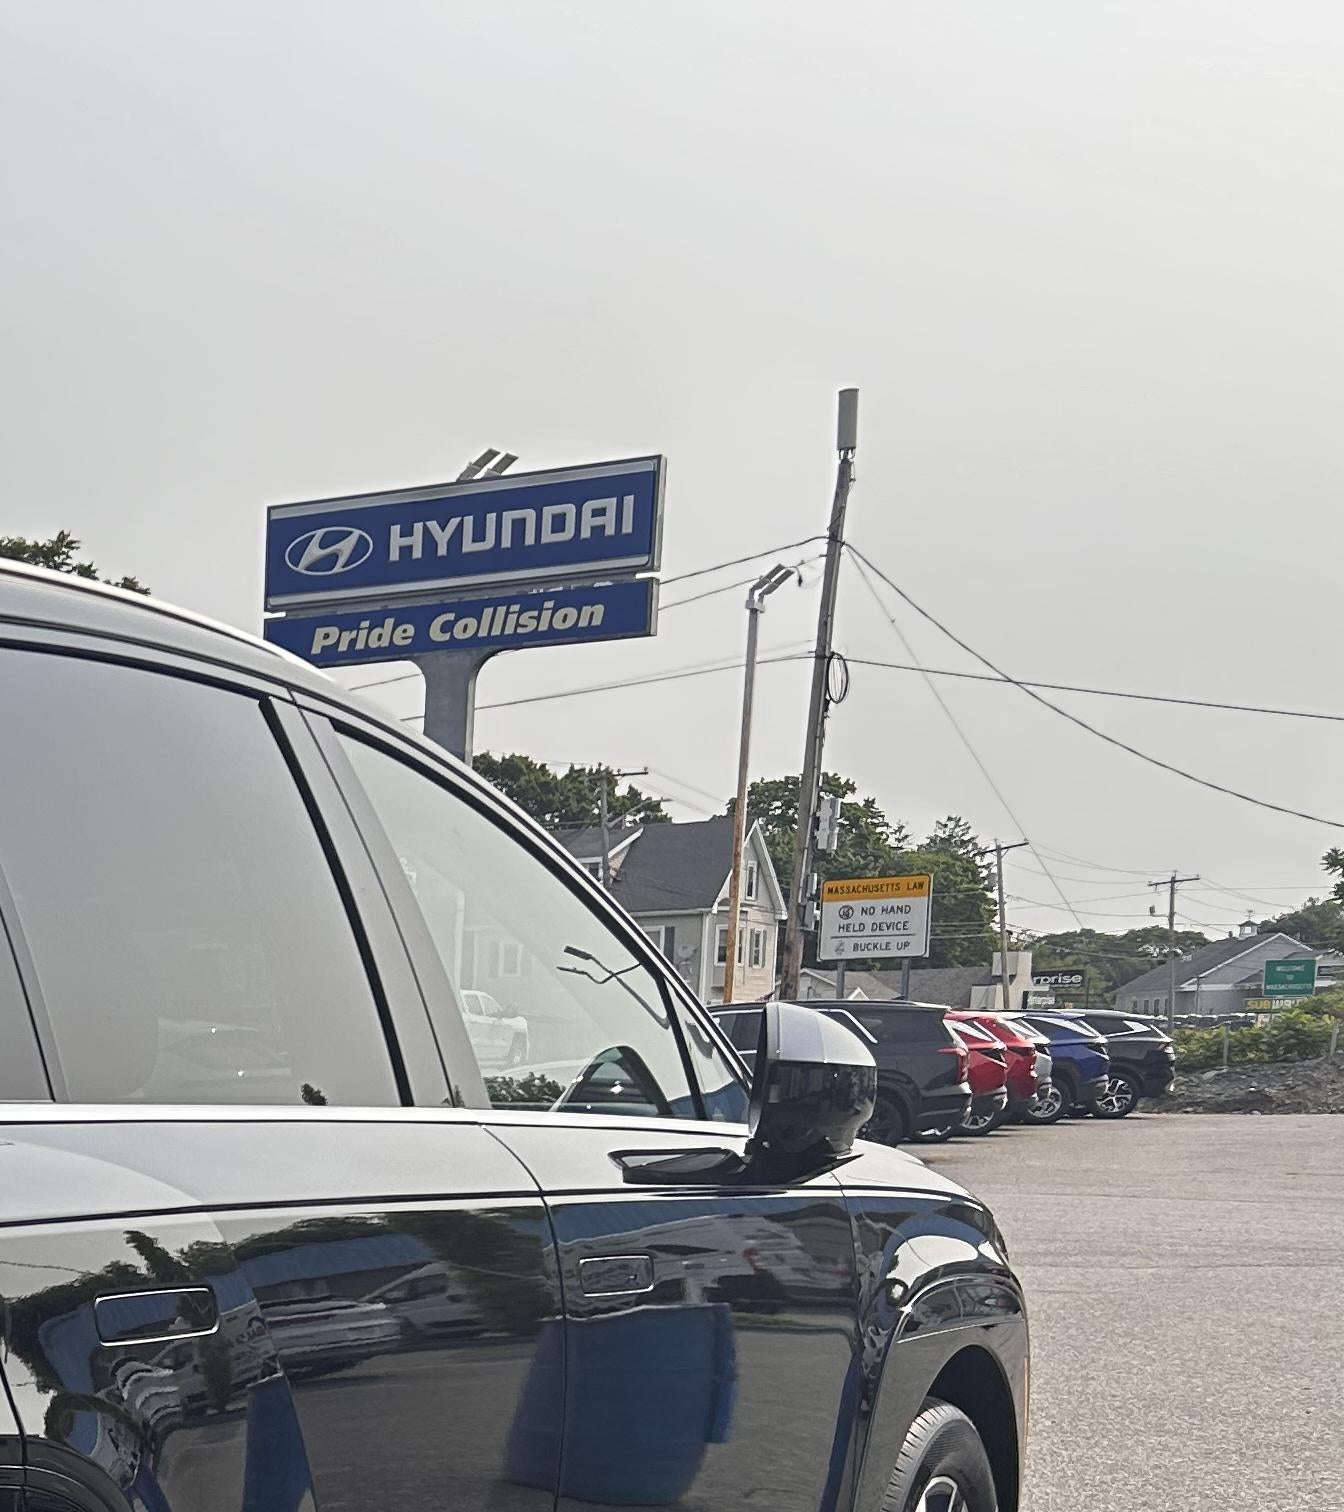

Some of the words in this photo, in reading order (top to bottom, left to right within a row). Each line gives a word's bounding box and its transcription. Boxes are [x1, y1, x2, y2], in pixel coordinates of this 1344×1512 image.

[388, 495, 635, 562] HYUNDAI
[311, 618, 415, 655] Pride
[428, 600, 605, 643] Collision
[827, 882, 901, 895] MASSACHUSETTS
[906, 881, 925, 891] LAW
[860, 906, 876, 916] NO
[881, 905, 911, 915] HAND
[838, 922, 865, 933] HELD
[871, 921, 909, 932] DEVICE
[852, 941, 891, 952] BUCKLE
[896, 941, 910, 951] UP
